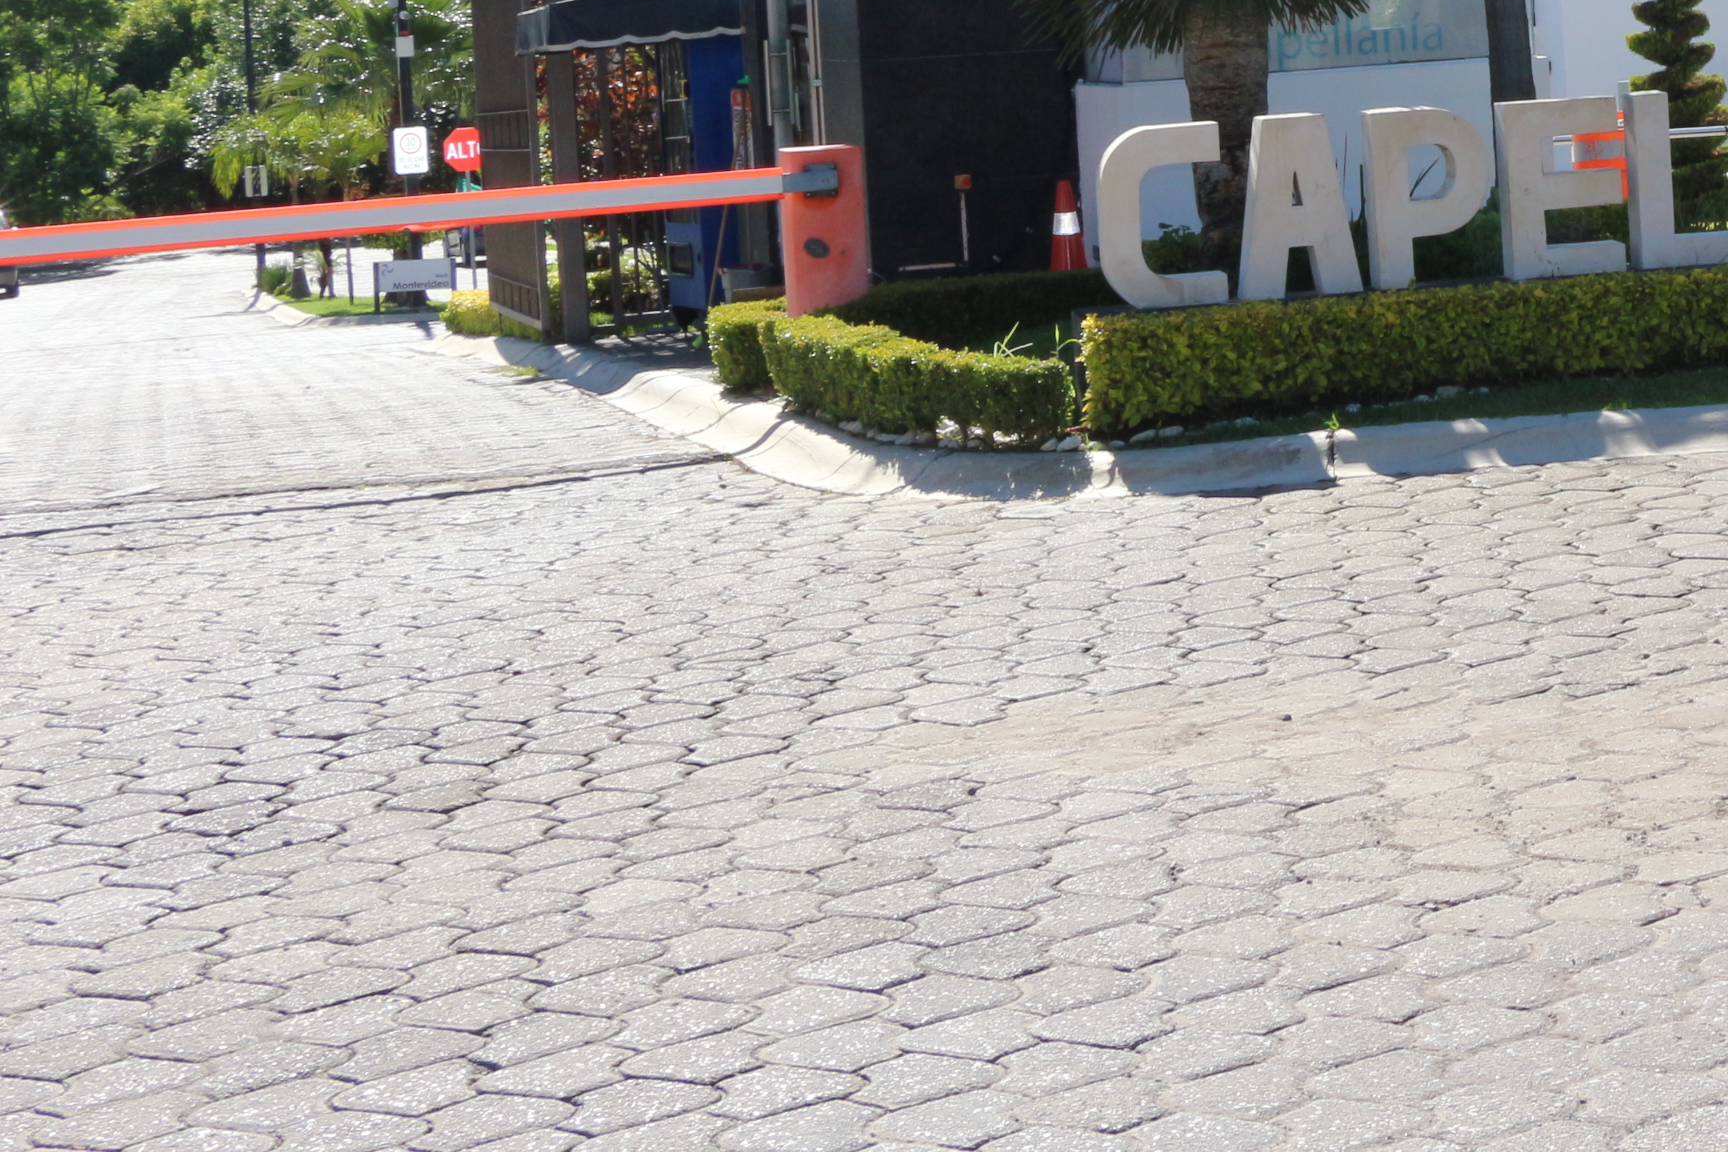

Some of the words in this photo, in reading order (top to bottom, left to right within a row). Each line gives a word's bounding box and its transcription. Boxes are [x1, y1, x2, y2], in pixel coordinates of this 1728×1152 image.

[1268, 11, 1444, 71] pellanía
[405, 137, 416, 147] 30
[393, 279, 449, 290] Montevideo
